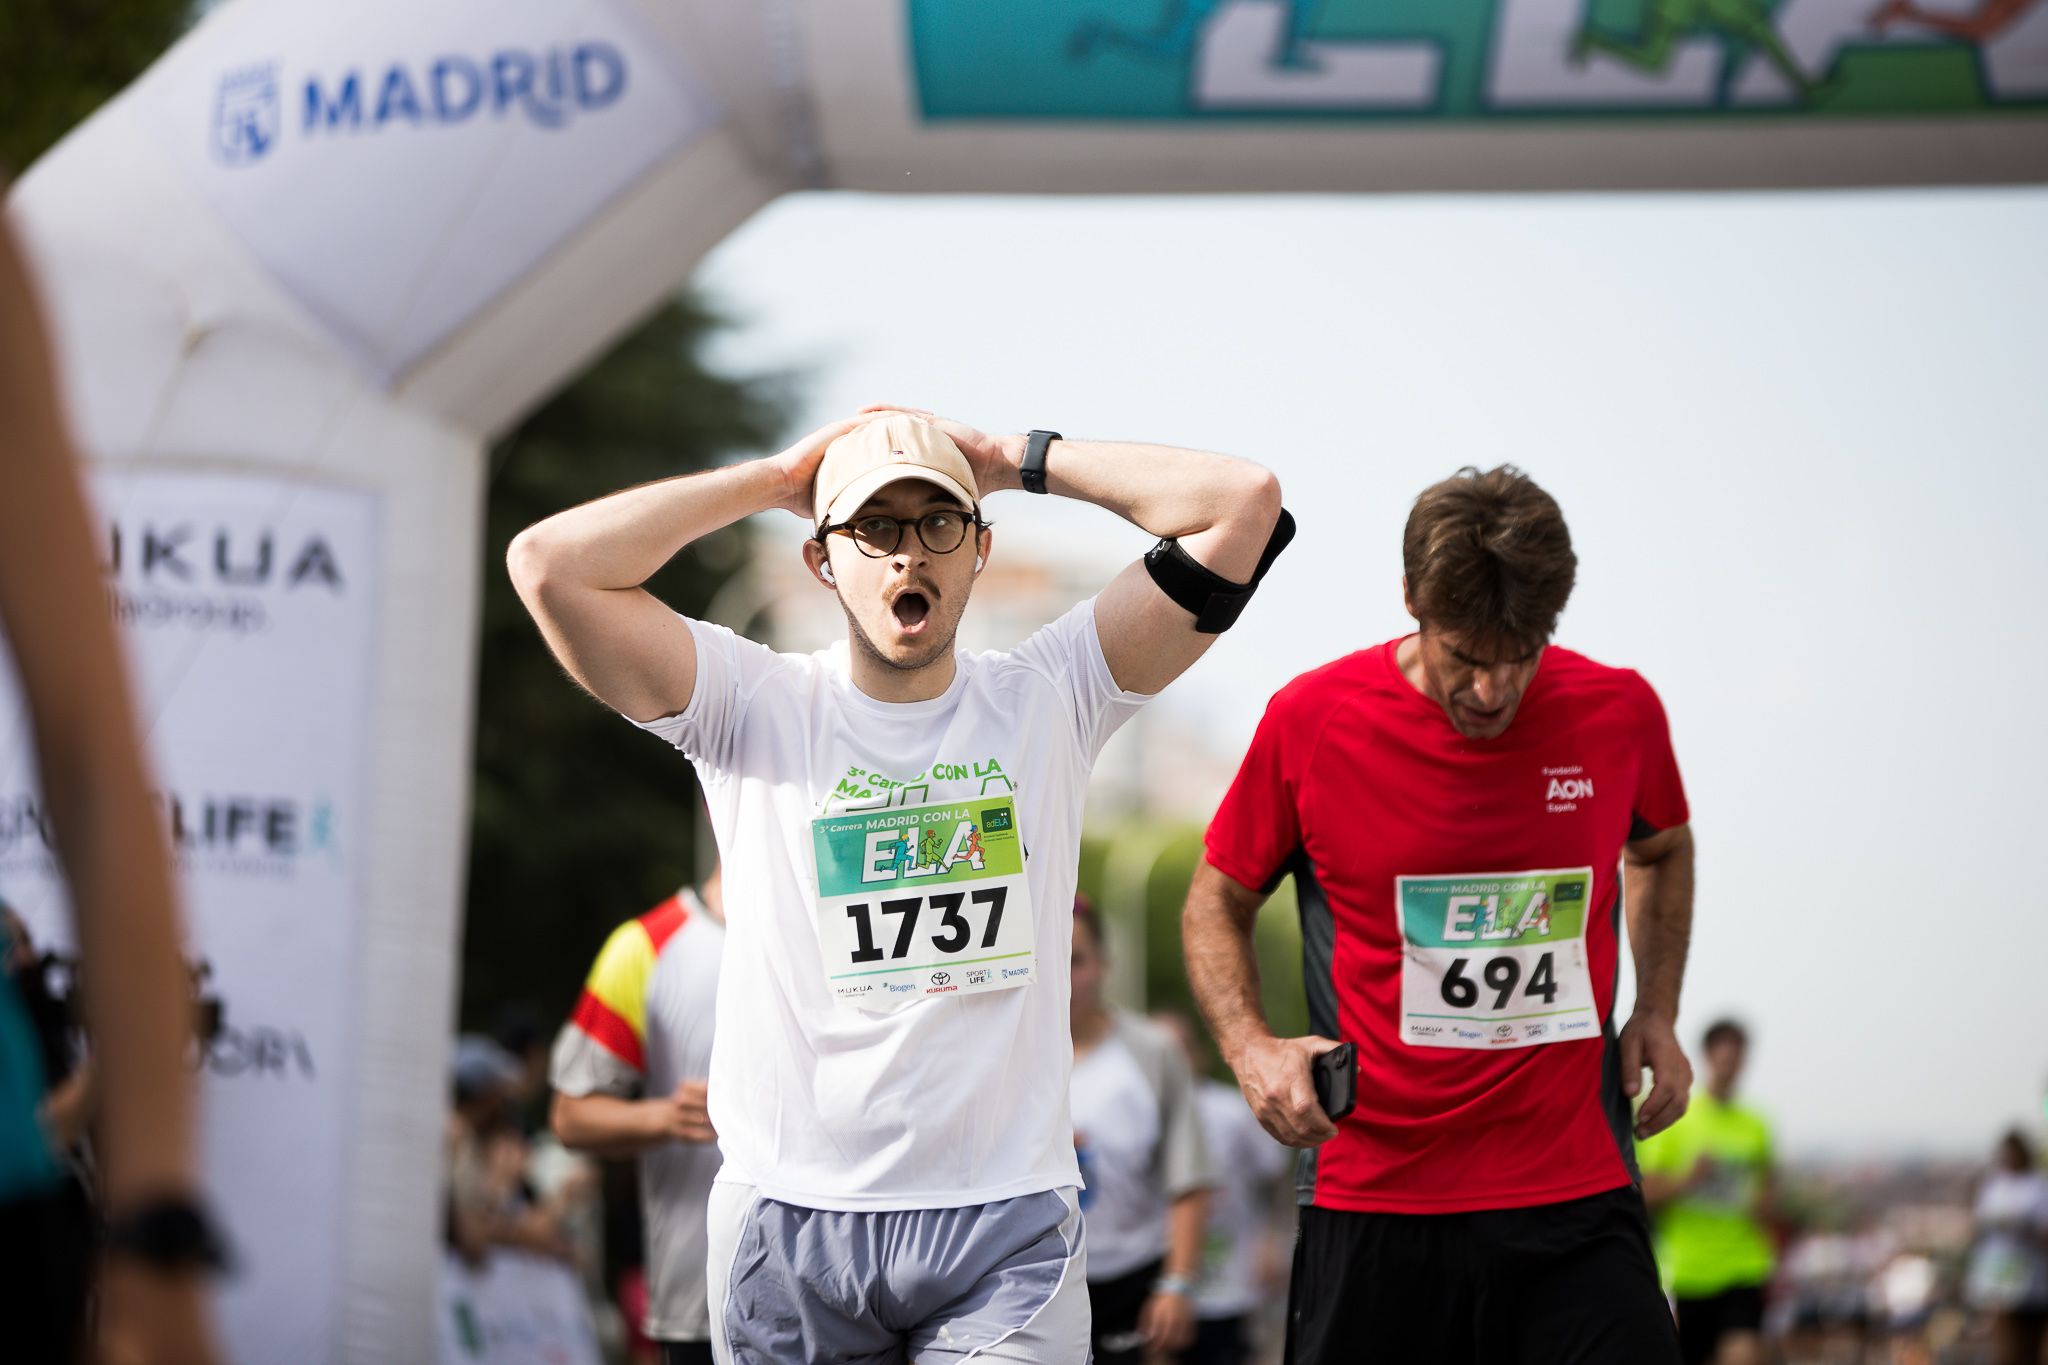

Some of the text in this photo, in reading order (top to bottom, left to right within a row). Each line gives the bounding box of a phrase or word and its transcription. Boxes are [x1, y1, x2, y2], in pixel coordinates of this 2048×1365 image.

[303, 40, 630, 133] MADRID
[932, 758, 1002, 781] CON LA
[1546, 777, 1594, 800] AON
[830, 823, 863, 833] Carrera
[866, 814, 920, 830] MADRID
[923, 811, 951, 823] CON
[954, 808, 971, 820] LA
[861, 819, 985, 884] ELA
[1451, 882, 1500, 895] MADRID
[1503, 881, 1529, 893] CON
[1531, 880, 1546, 891] LA
[846, 886, 1008, 963] 1737
[1443, 892, 1551, 941] ELA
[966, 969, 987, 978] SPORT
[969, 976, 985, 984] LIFE
[1008, 967, 1029, 977] MADRID
[1440, 952, 1557, 1011] 694
[837, 985, 873, 995] MUKUA
[889, 983, 916, 993] Biogen
